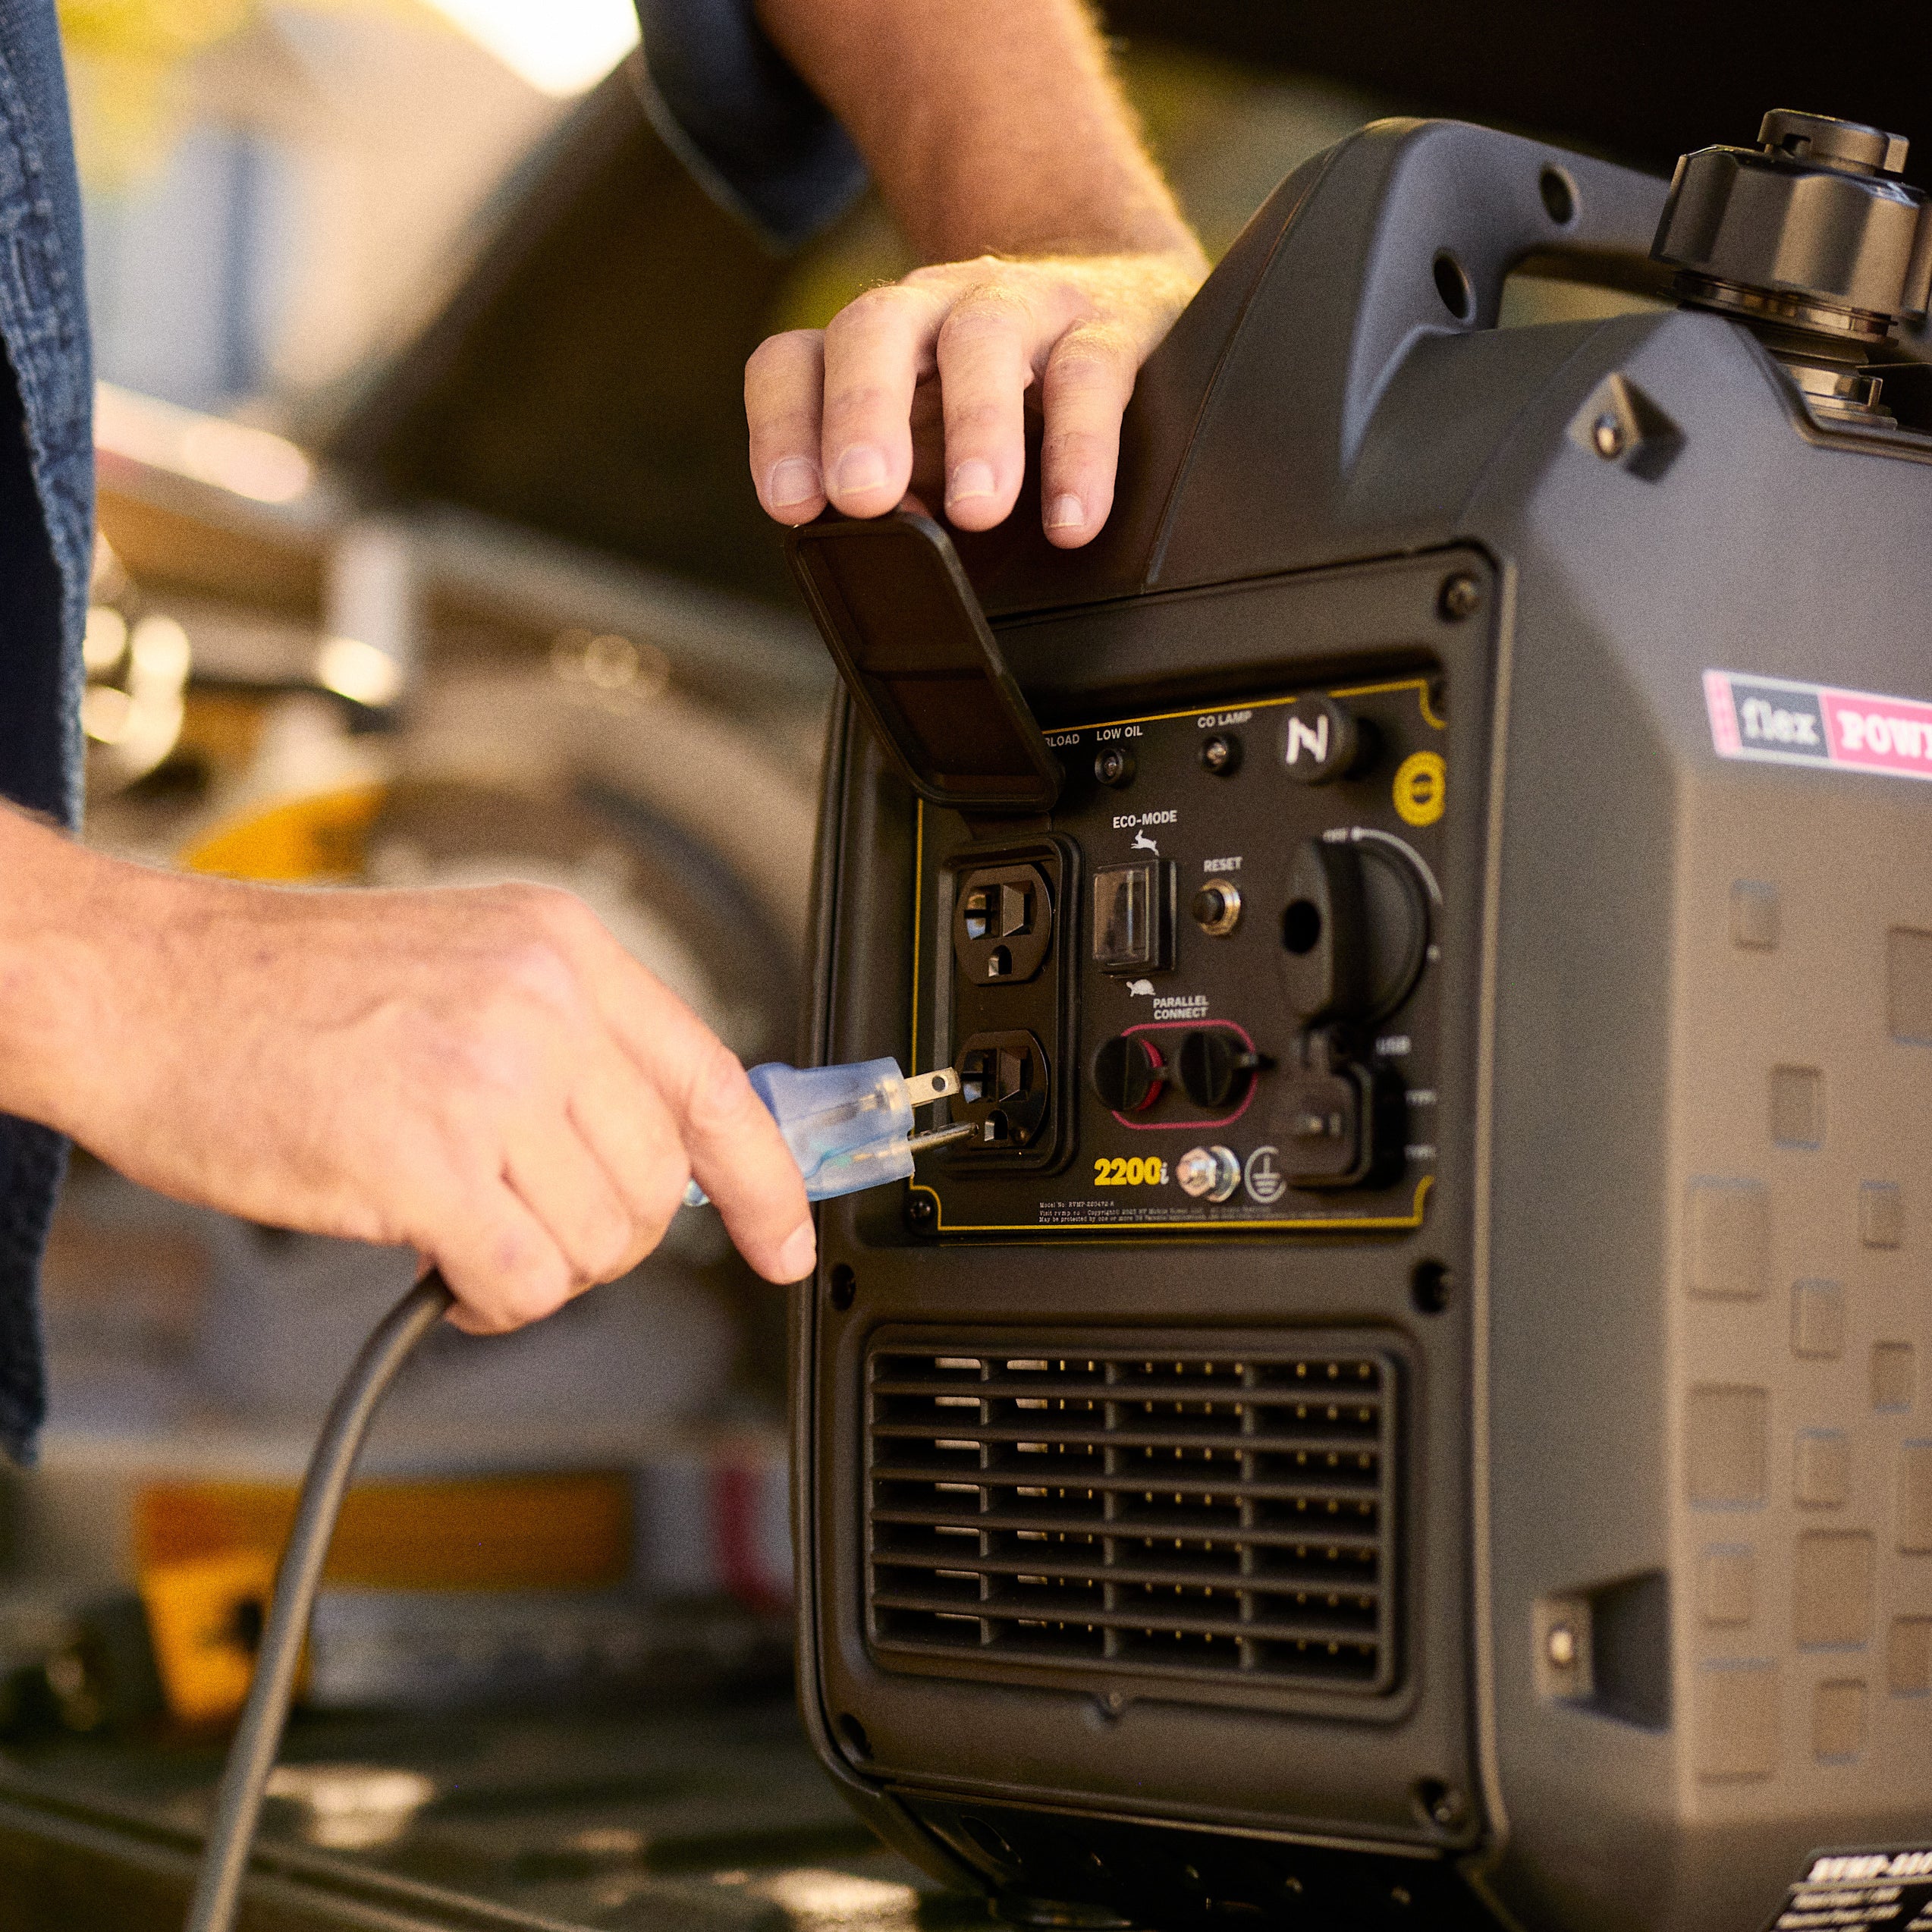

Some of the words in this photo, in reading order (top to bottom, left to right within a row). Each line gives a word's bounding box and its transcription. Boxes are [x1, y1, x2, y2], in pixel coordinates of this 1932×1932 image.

[1197, 715, 1216, 728] CO
[1217, 710, 1252, 726] LAMP
[1097, 727, 1121, 741] LOW
[1125, 725, 1143, 737] OIL
[1286, 714, 1329, 765] N
[1113, 810, 1177, 828] ECO-MODE
[1203, 856, 1243, 872] RESET
[1153, 994, 1209, 1008] PARALLEL
[1154, 1007, 1208, 1019] CONNECT
[1094, 1157, 1169, 1186] 2200i
